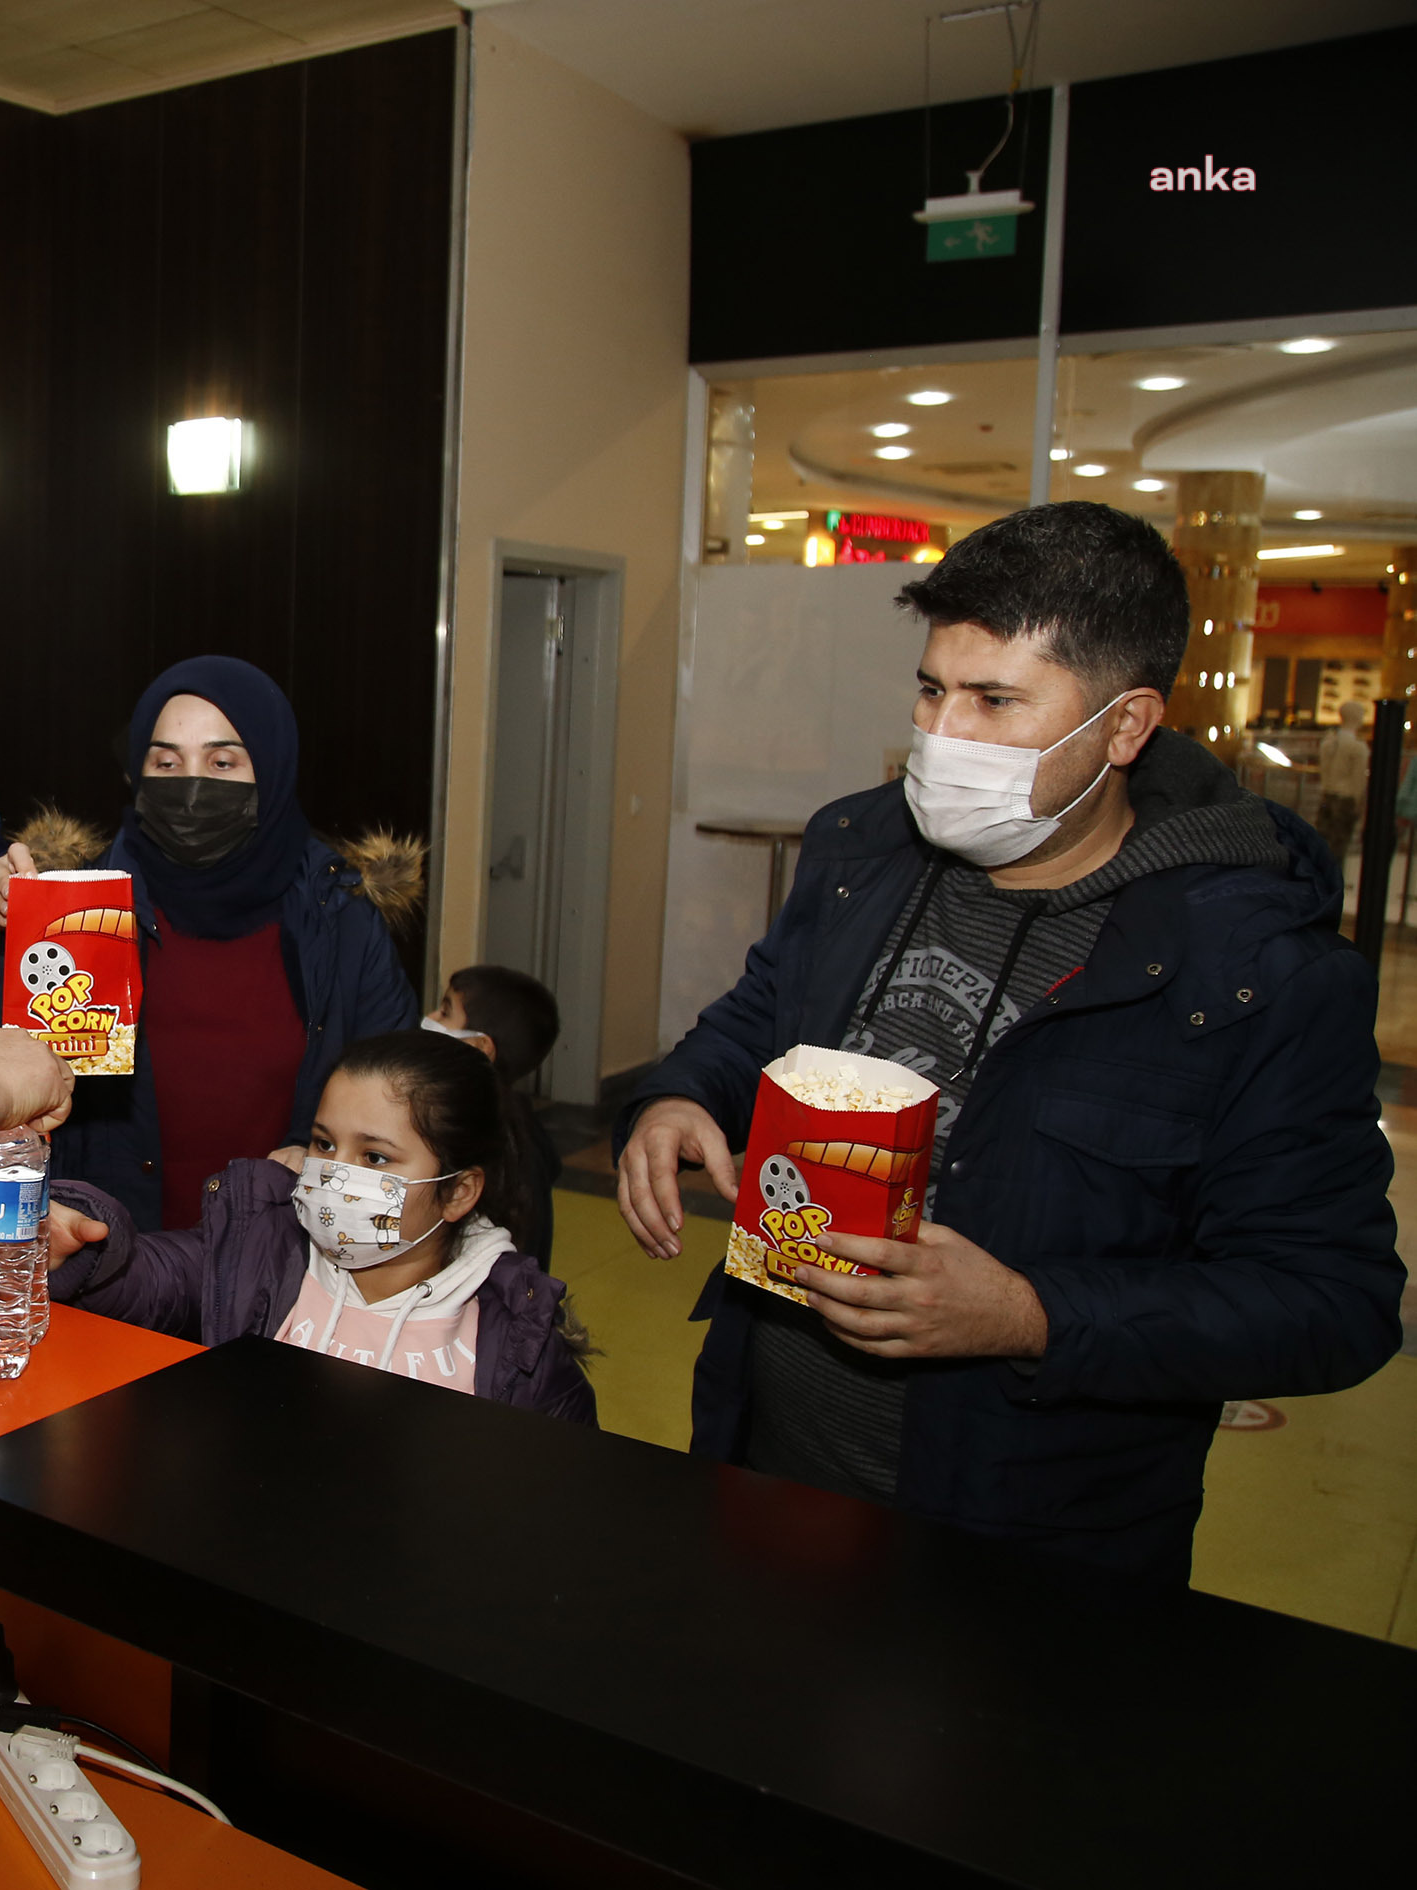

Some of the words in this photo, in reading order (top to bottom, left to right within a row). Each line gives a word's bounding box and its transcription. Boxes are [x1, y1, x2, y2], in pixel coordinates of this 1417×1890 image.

[30, 973, 92, 1022] POP
[50, 1009, 116, 1034] CORN
[47, 1035, 97, 1052] mini
[762, 1207, 829, 1241] POP
[779, 1240, 855, 1275] CORN
